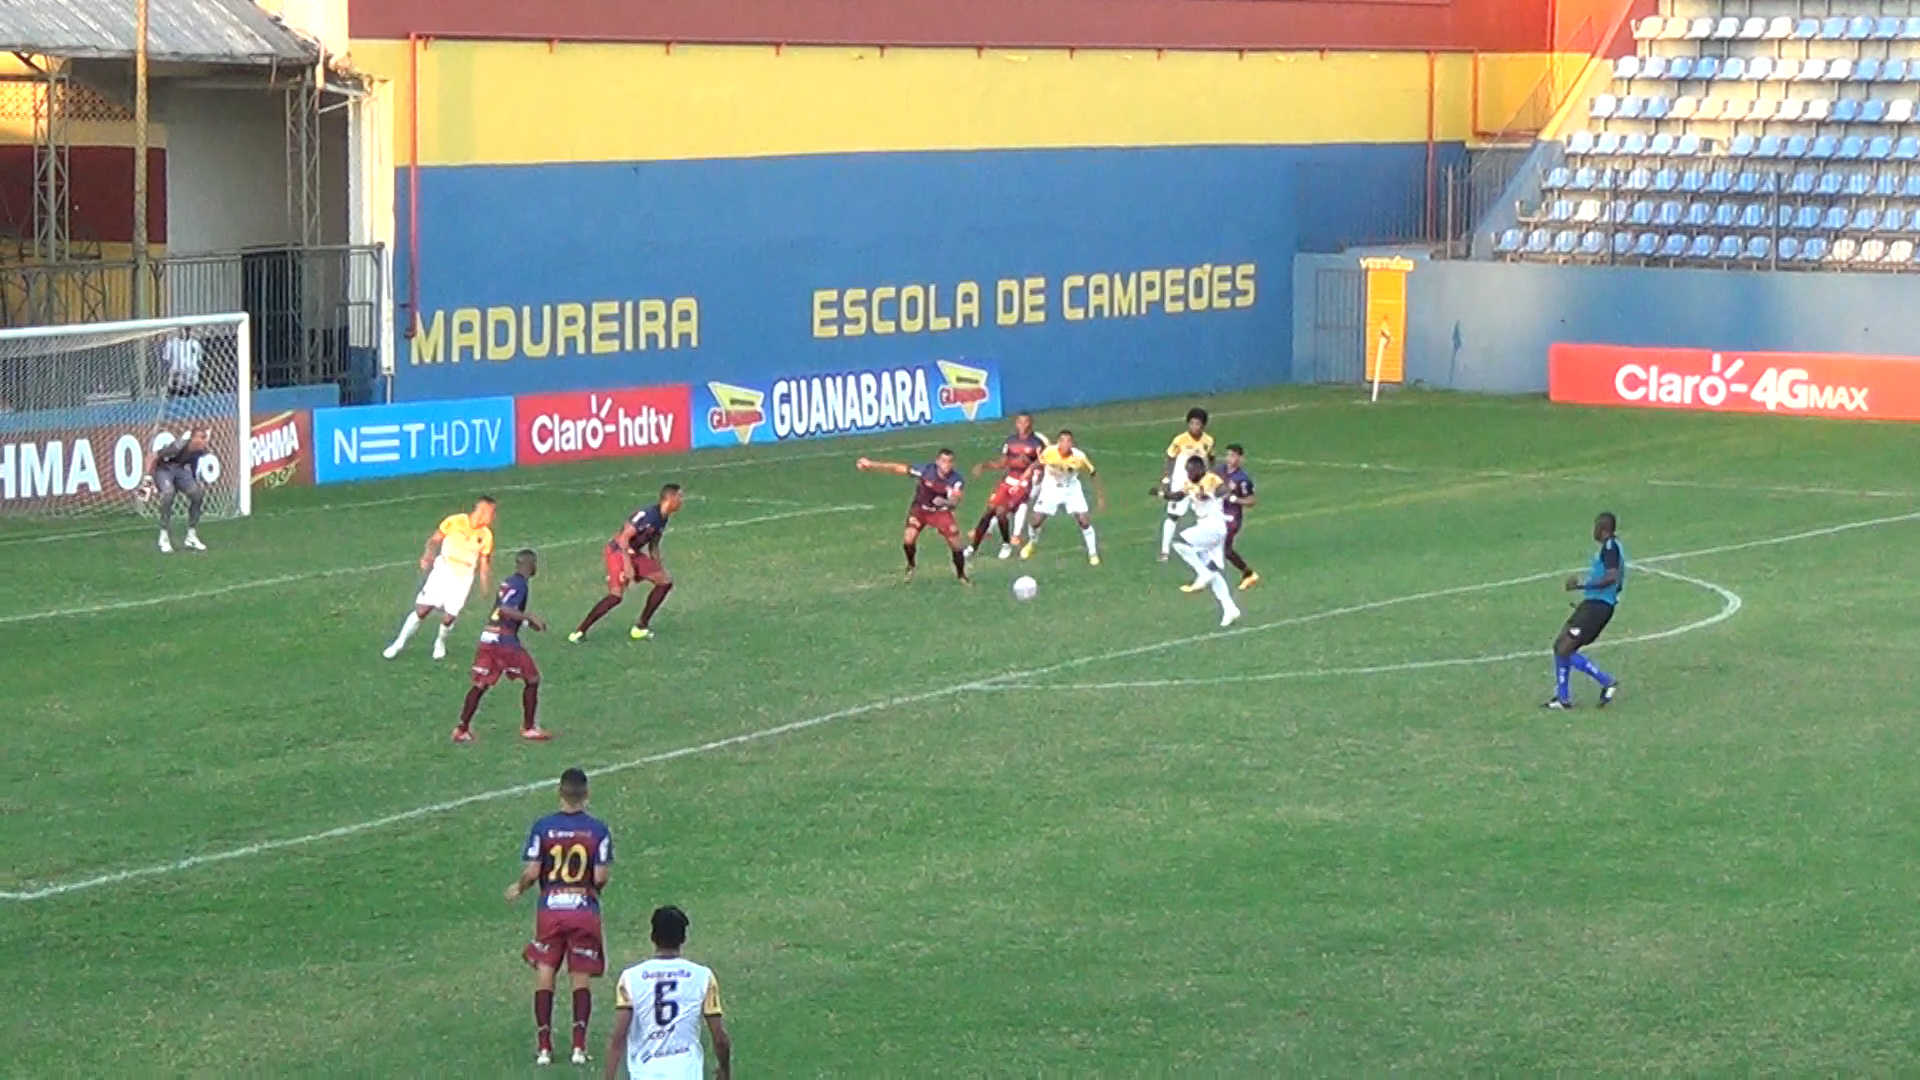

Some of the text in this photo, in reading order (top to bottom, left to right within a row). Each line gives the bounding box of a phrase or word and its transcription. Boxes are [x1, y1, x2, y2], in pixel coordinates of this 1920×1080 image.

[410, 296, 699, 366] MADUREIRA
[812, 281, 979, 339] ESCOLA
[997, 276, 1046, 326] DE
[772, 367, 932, 438] GUANABARA
[1615, 362, 1727, 406] Claro
[249, 420, 300, 468] RAHMA
[333, 417, 501, 466] NET HDTV
[531, 409, 605, 455] Claro
[547, 843, 588, 884] 10
[654, 980, 679, 1026] 6
